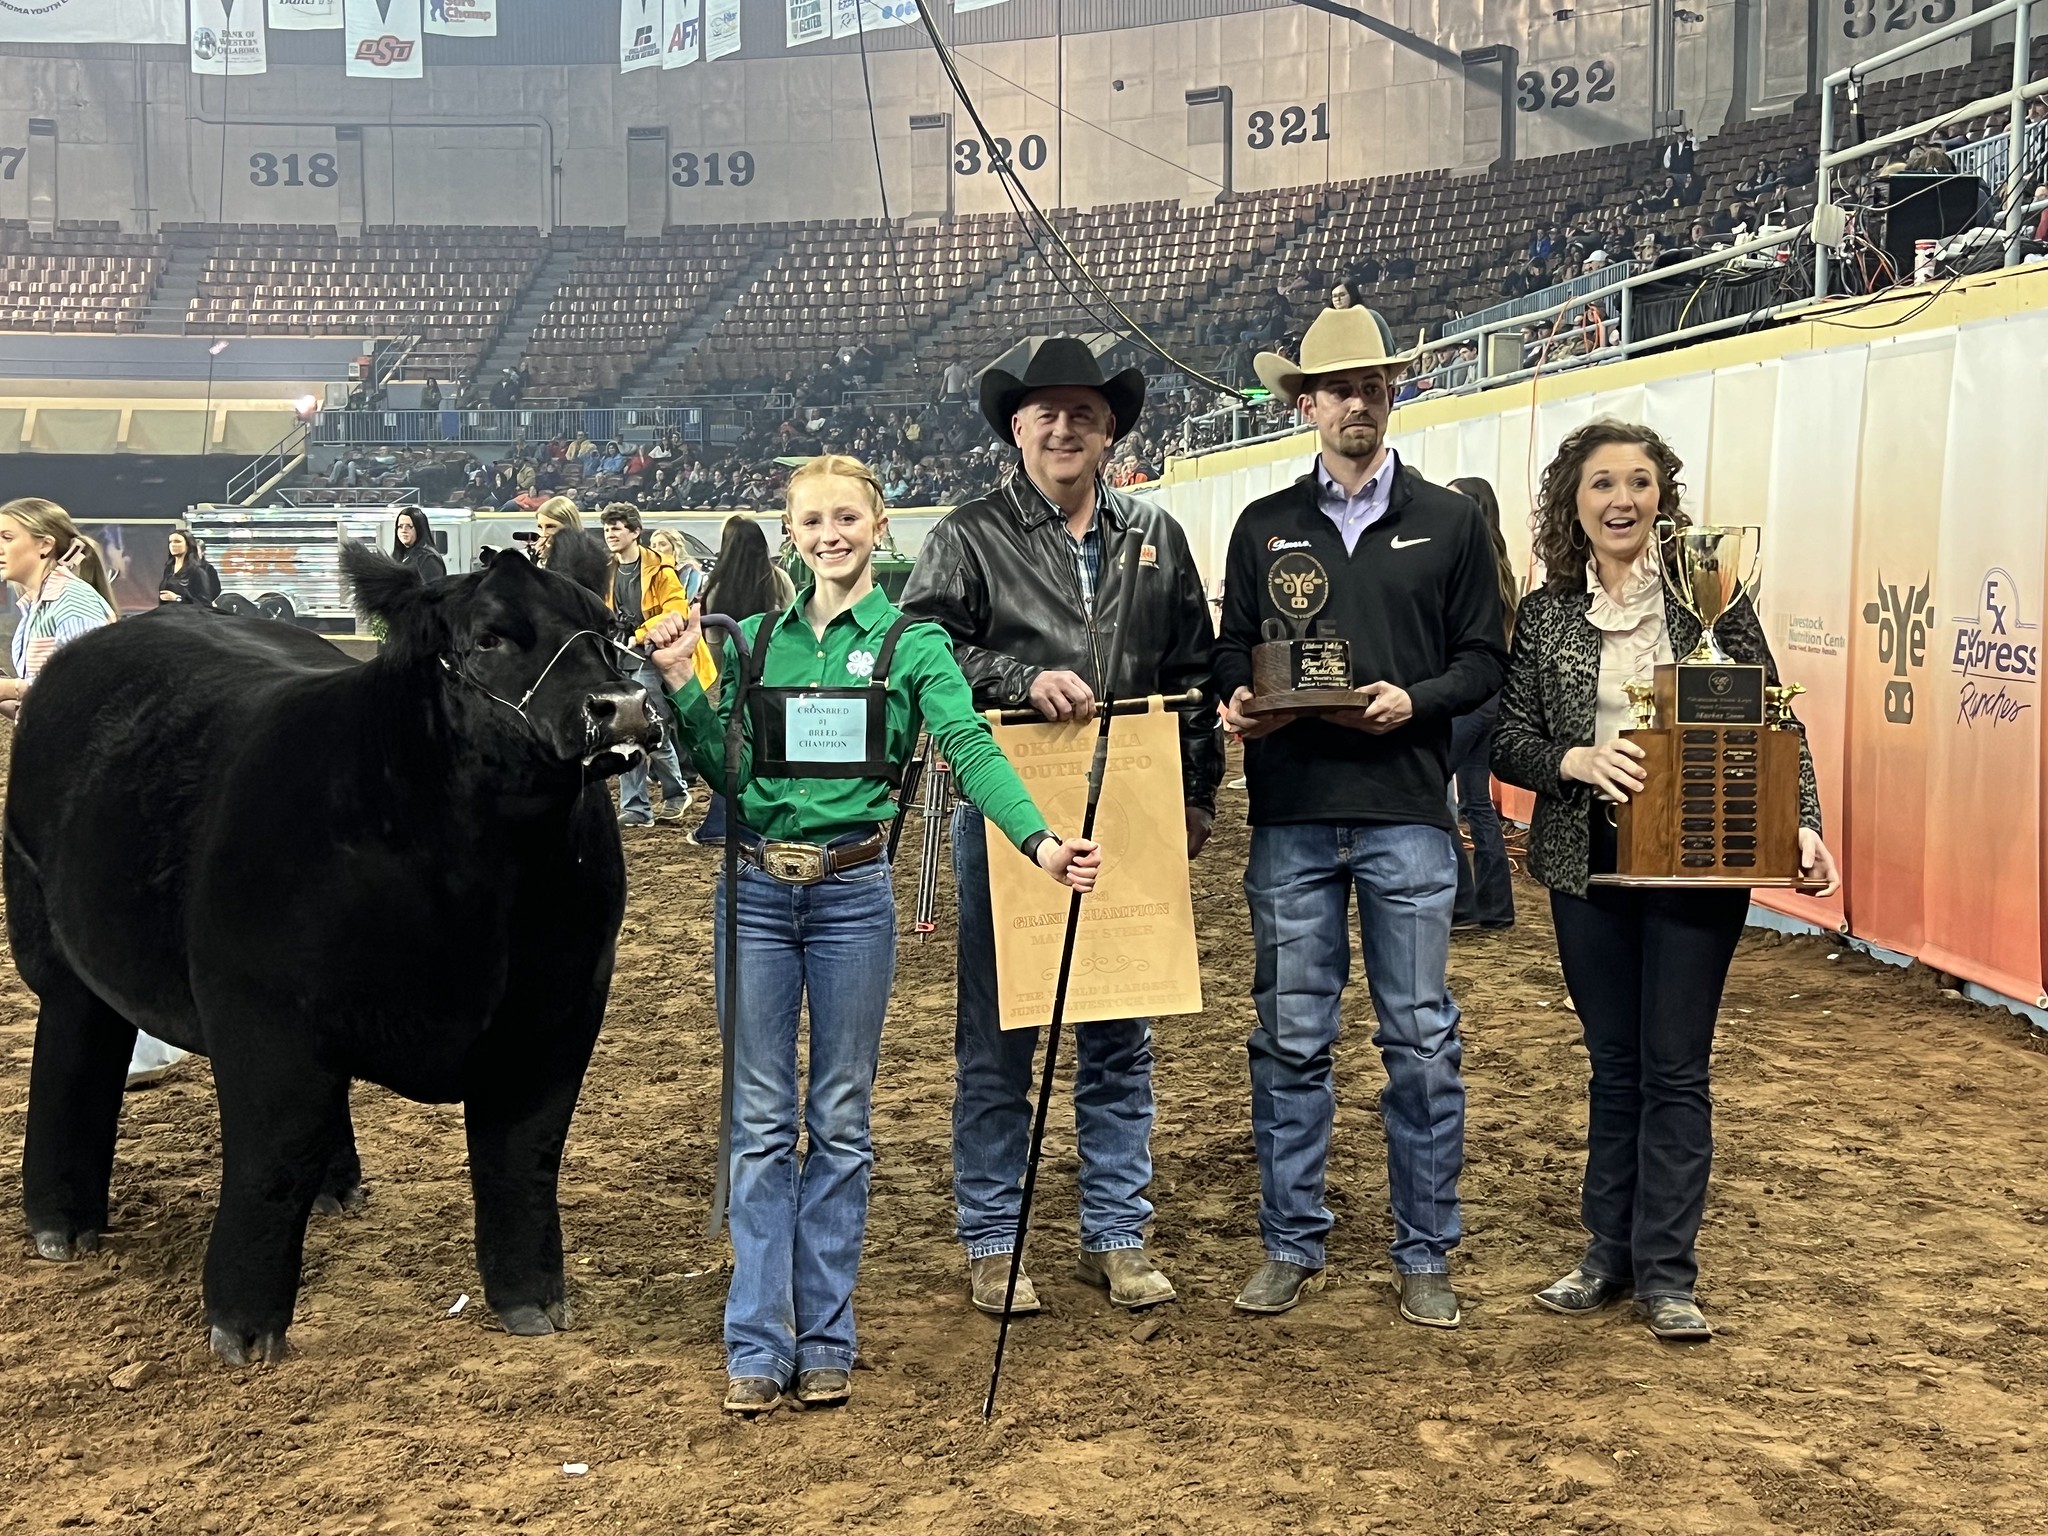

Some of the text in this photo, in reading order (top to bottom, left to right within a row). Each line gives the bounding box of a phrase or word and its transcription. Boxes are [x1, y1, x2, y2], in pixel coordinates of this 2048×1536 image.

[30, 2, 61, 15] YOUTH
[221, 29, 243, 38] BANK
[354, 35, 415, 66] OSU
[1517, 60, 1615, 112] 322
[1247, 103, 1329, 149] 321
[954, 134, 1047, 175] 320
[249, 152, 338, 188] 318
[672, 151, 755, 187] 319
[1789, 614, 1824, 630] Livestock
[1789, 628, 1822, 645] Nutrition
[1957, 681, 2032, 729] Ranches
[808, 729, 838, 737] BREED
[798, 740, 847, 748] CHAMPION
[1013, 733, 1143, 758] OKLAHMA
[1107, 755, 1152, 773] XPO
[1016, 991, 1044, 1002] THE
[1010, 1004, 1051, 1018] JUNIO
